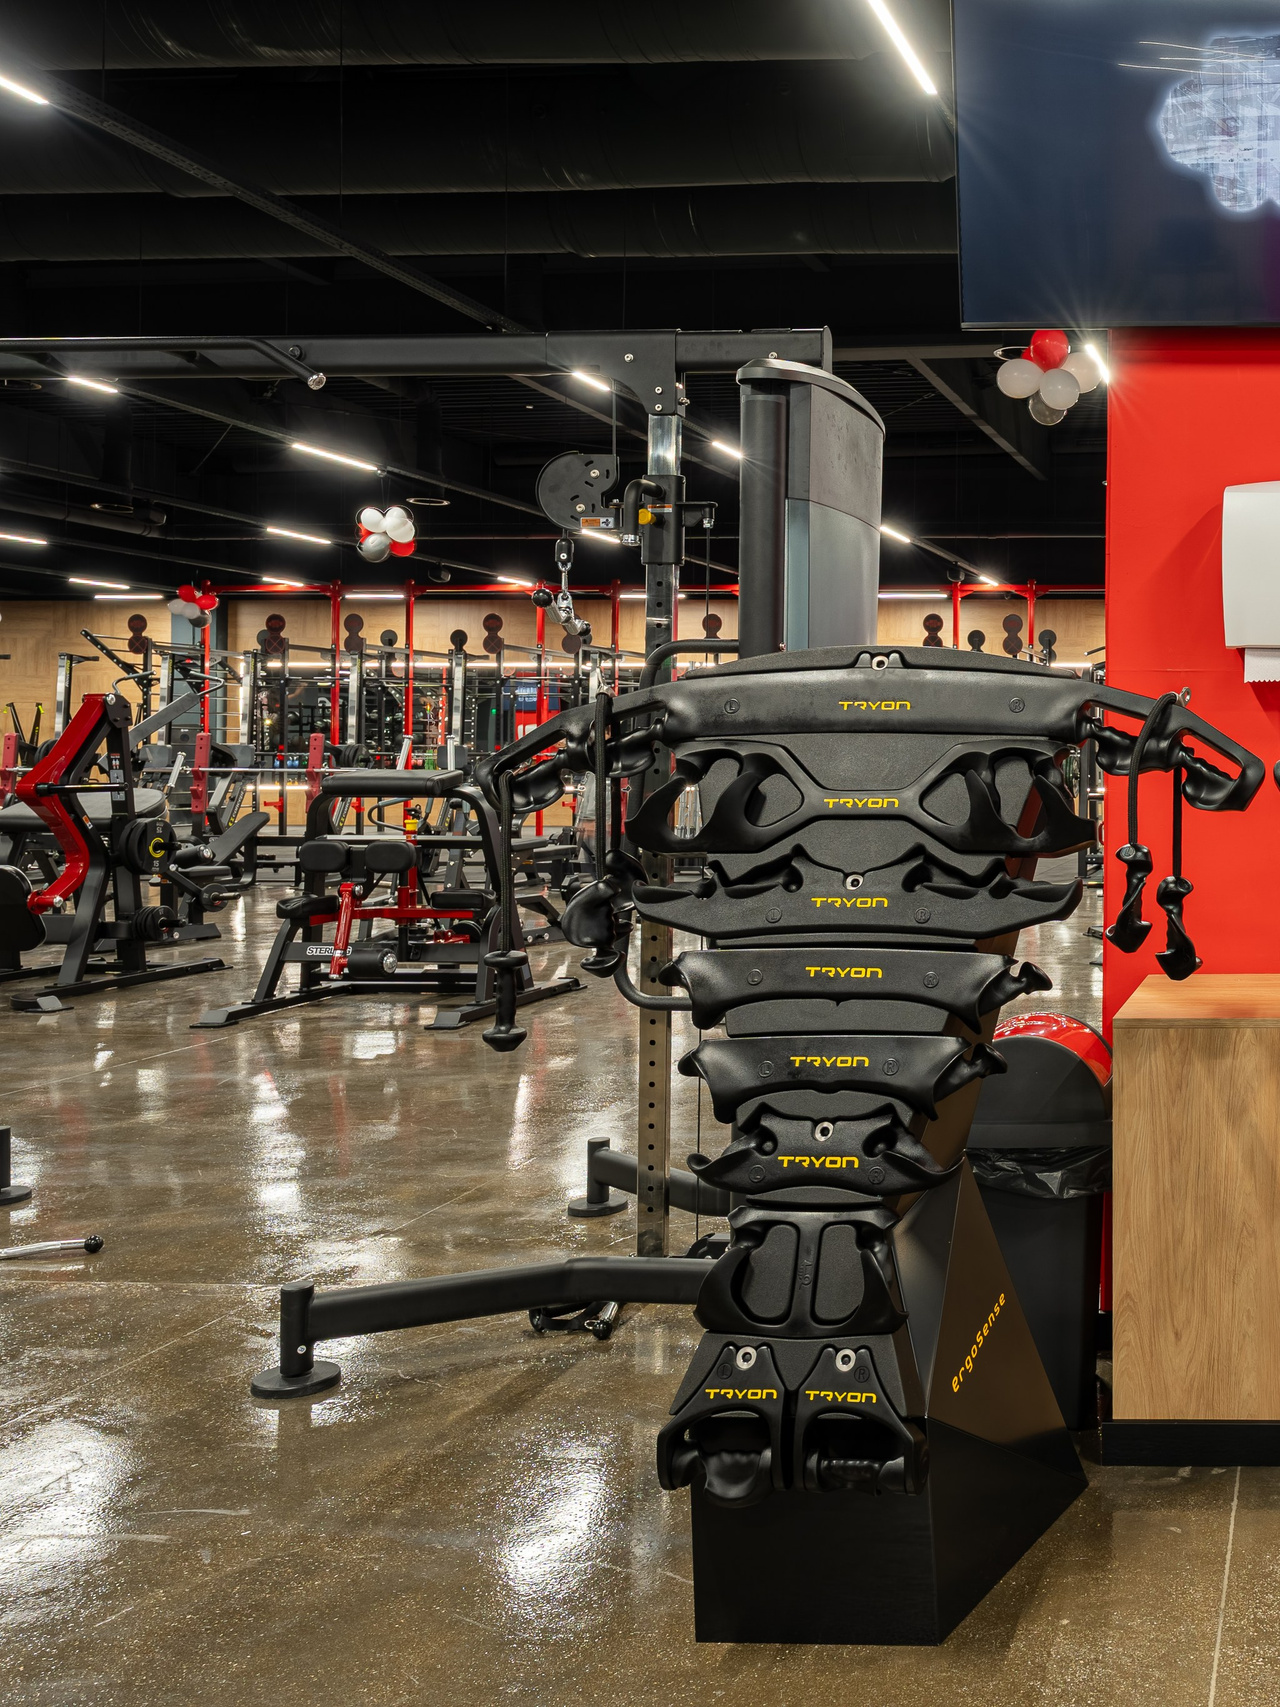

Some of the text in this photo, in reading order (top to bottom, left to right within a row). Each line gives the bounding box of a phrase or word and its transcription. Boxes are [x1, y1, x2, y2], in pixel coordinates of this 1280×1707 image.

[838, 700, 912, 711] TRYON
[823, 797, 900, 809] TRYON
[810, 896, 889, 909] TRYON
[306, 945, 352, 956] STERLG
[804, 966, 883, 979] TRYON
[789, 1055, 870, 1068] TRYON
[777, 1155, 860, 1169] TRYON
[704, 1388, 778, 1400] TRYON
[804, 1390, 877, 1404] TRYON
